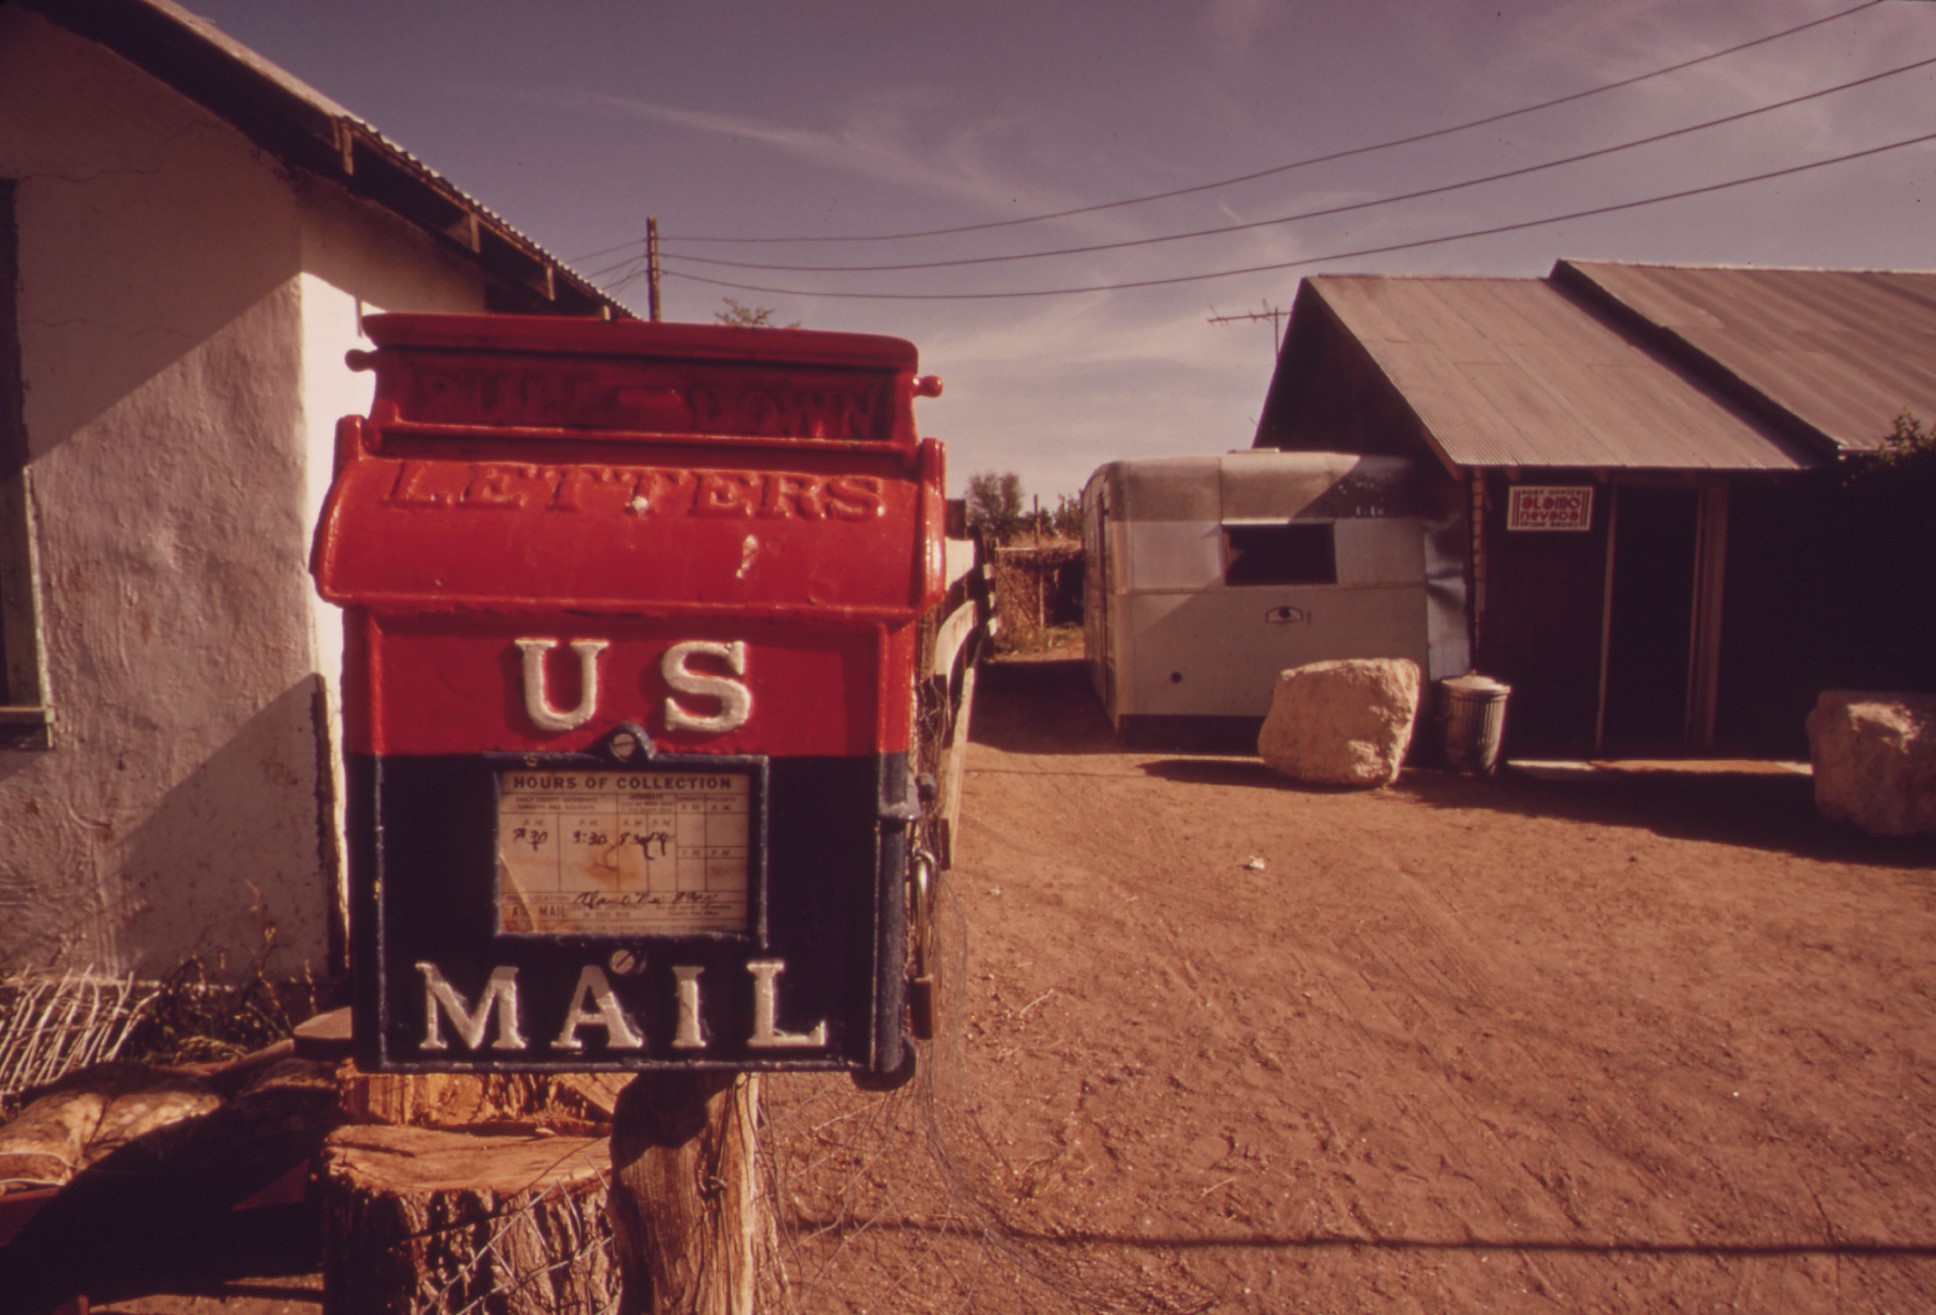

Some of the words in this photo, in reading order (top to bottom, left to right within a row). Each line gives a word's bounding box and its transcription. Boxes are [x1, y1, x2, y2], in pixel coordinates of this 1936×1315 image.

[385, 459, 887, 521] LETTERS
[513, 776, 577, 790] HOURS
[585, 776, 608, 790] OF
[616, 776, 732, 790] COLLECTION
[539, 905, 568, 918] MAIL
[415, 960, 828, 1050] MAIL
